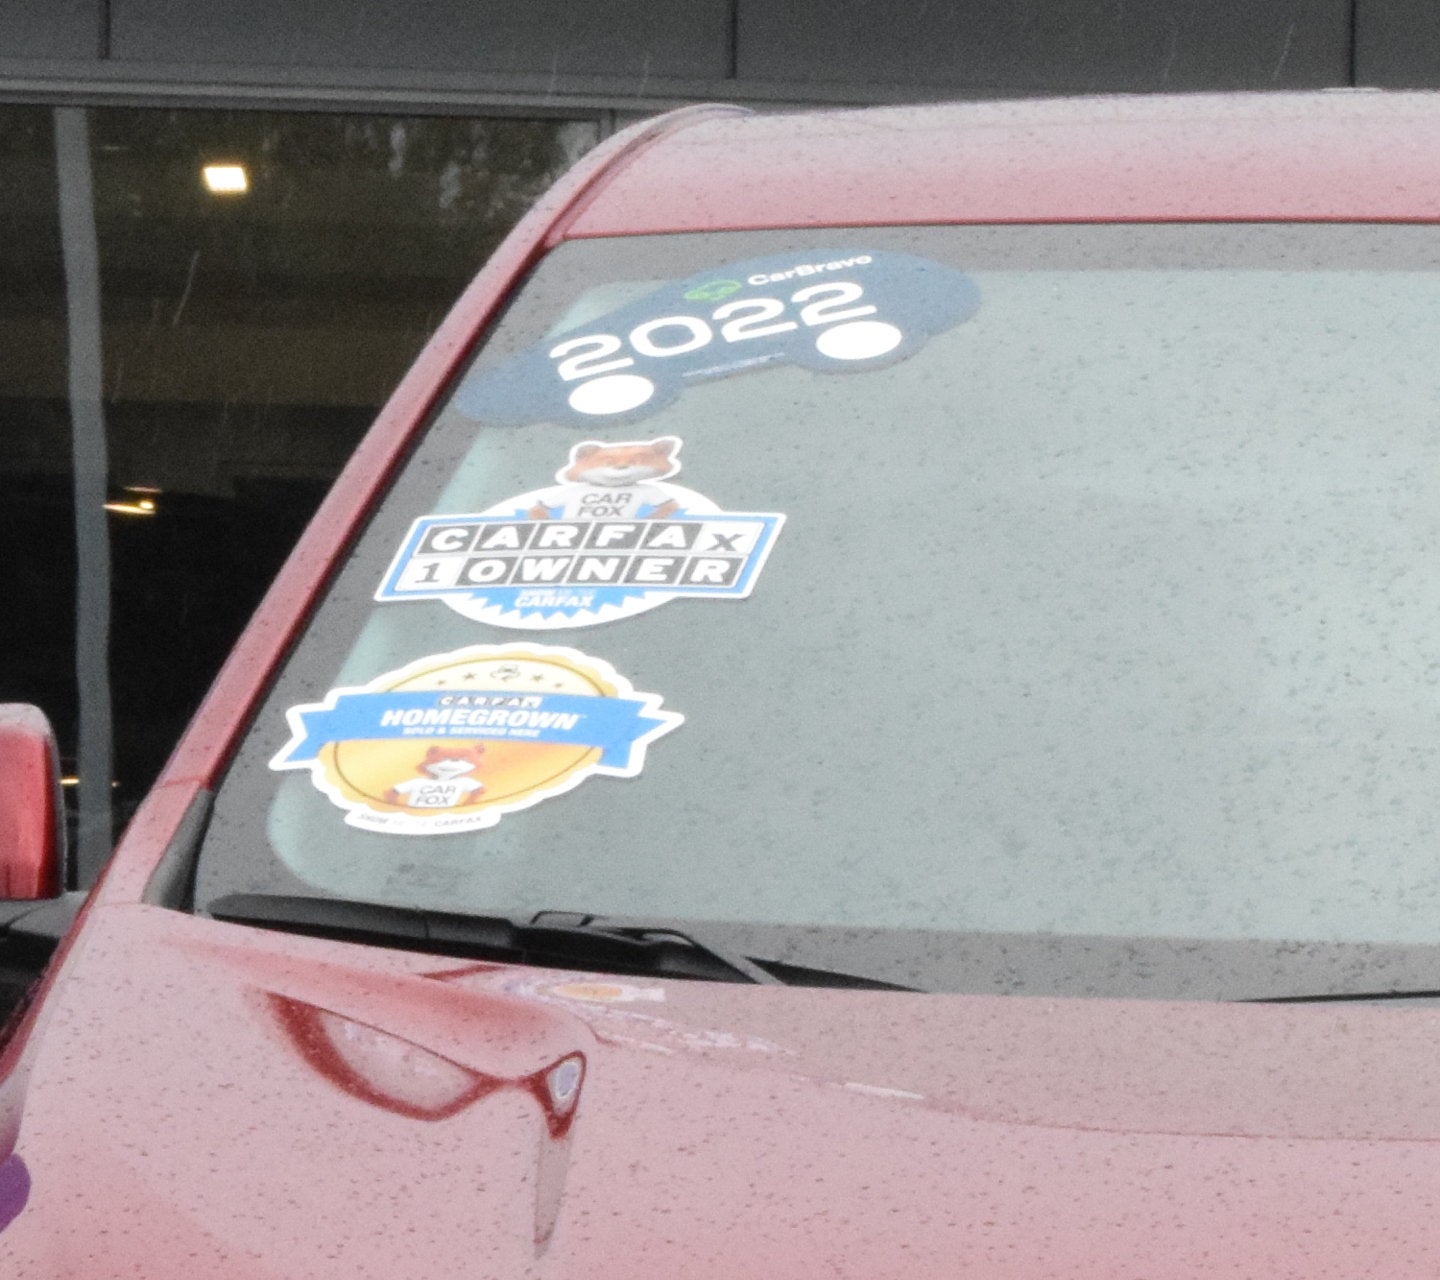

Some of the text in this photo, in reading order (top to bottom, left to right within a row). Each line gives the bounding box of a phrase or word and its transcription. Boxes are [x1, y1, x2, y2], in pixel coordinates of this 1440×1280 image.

[747, 255, 873, 286] CarBravo
[549, 281, 878, 382] 2022
[580, 492, 633, 505] CAR
[576, 505, 626, 518] FOX
[430, 524, 745, 553] CARFAX
[414, 556, 732, 584] 1 OWNER
[380, 708, 580, 731] HOMEGROWN
[415, 796, 450, 806] FOX
[420, 785, 457, 795] CAR
